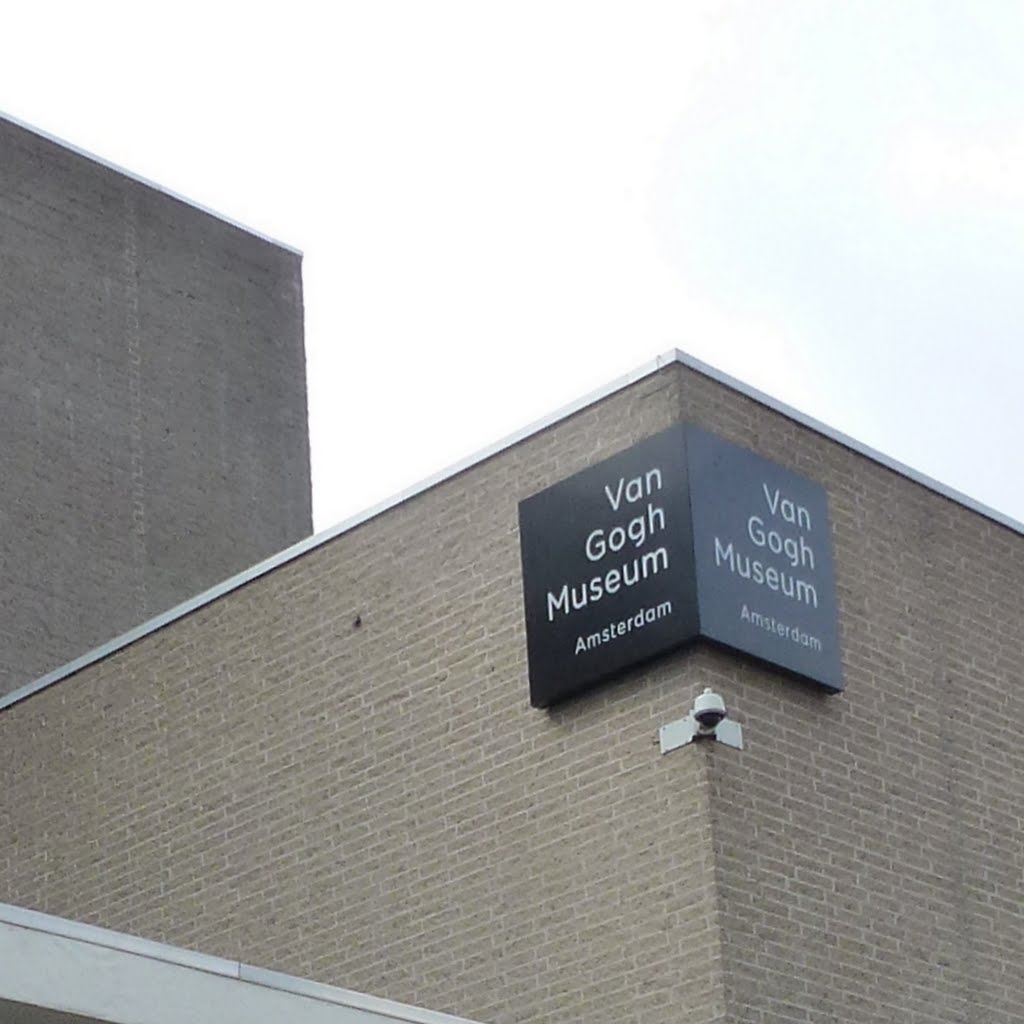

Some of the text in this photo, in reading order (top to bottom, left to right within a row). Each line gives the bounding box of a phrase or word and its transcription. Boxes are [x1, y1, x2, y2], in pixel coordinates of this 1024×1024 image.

[604, 468, 662, 511] Van
[763, 483, 811, 530] Van
[585, 503, 665, 561] Gogh
[747, 516, 815, 569] Gogh
[547, 547, 668, 621] Museum
[714, 537, 818, 608] Museum
[575, 601, 672, 655] Amsterdam
[740, 605, 821, 651] Amsterdam
